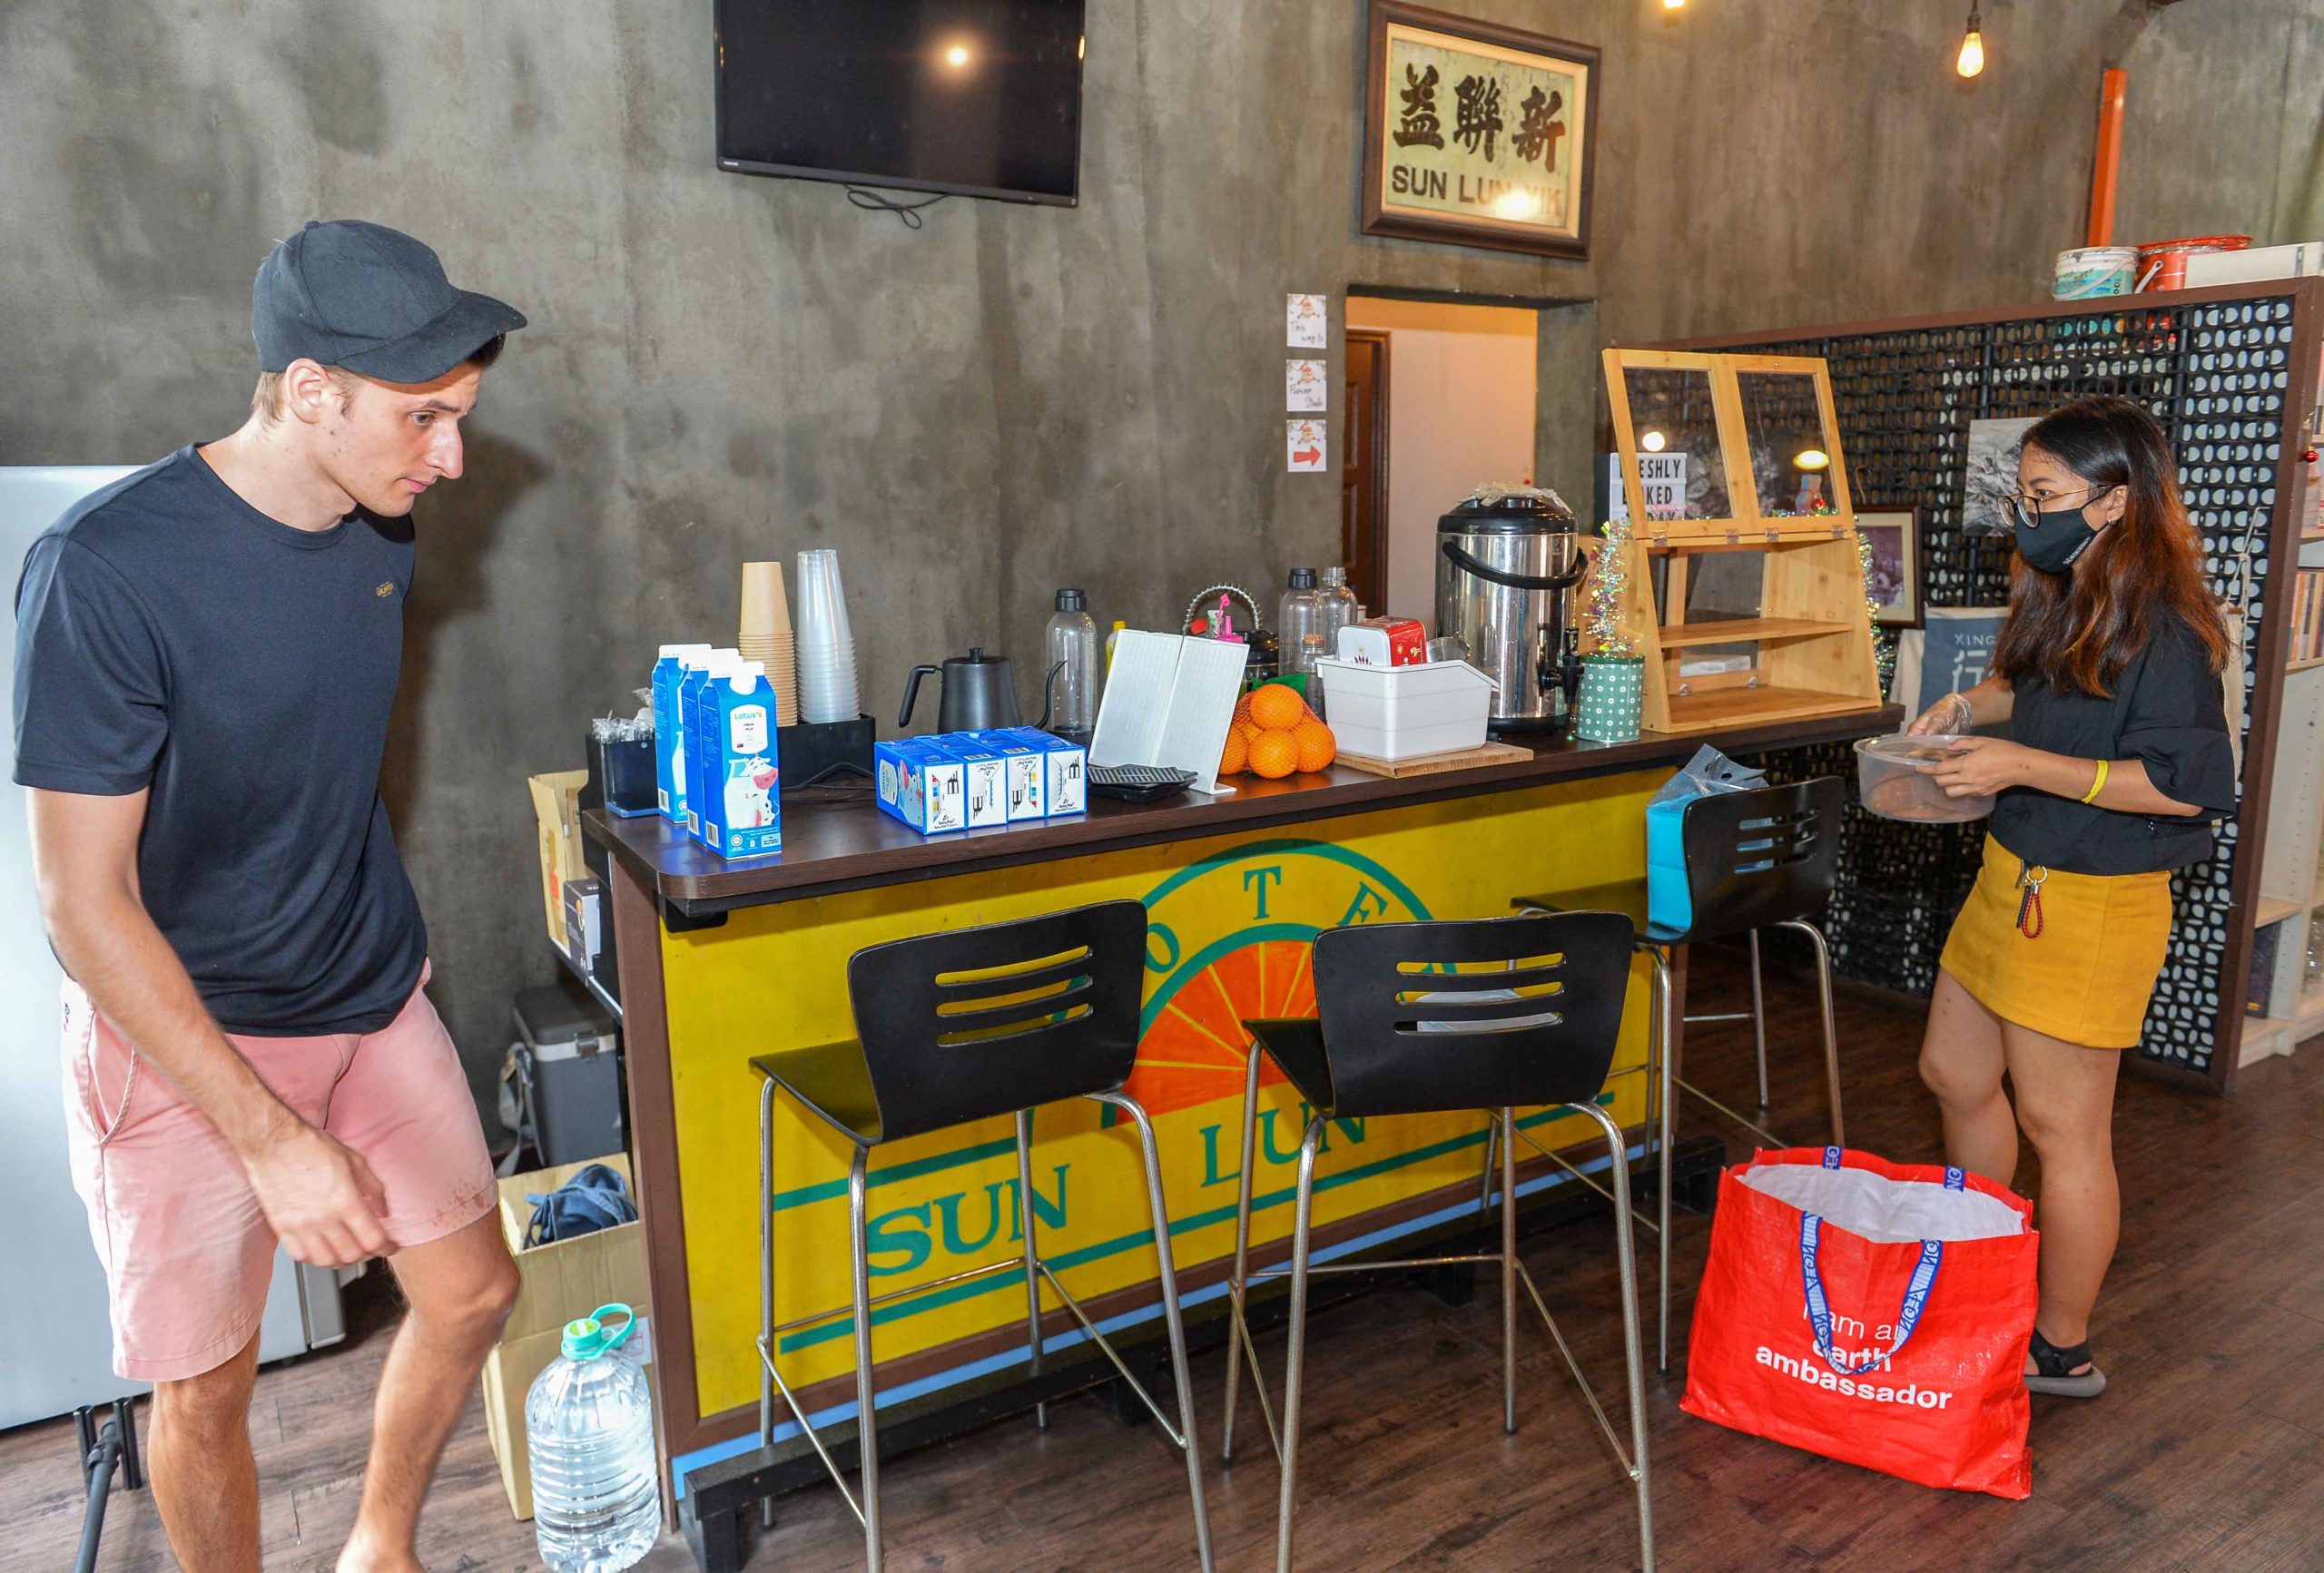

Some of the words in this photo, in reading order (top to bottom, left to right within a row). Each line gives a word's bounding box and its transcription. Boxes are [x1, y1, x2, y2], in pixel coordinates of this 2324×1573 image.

[1393, 165, 1447, 200] SUN
[1620, 460, 1680, 478] ESHLY
[1622, 486, 1672, 505] KED
[1955, 634, 1995, 646] XING
[734, 712, 763, 720] Lotus's
[1145, 865, 1389, 974] OTE
[867, 1164, 1070, 1277] SUN
[1812, 1338, 1892, 1373] earth
[1755, 1345, 1953, 1410] ambassador
